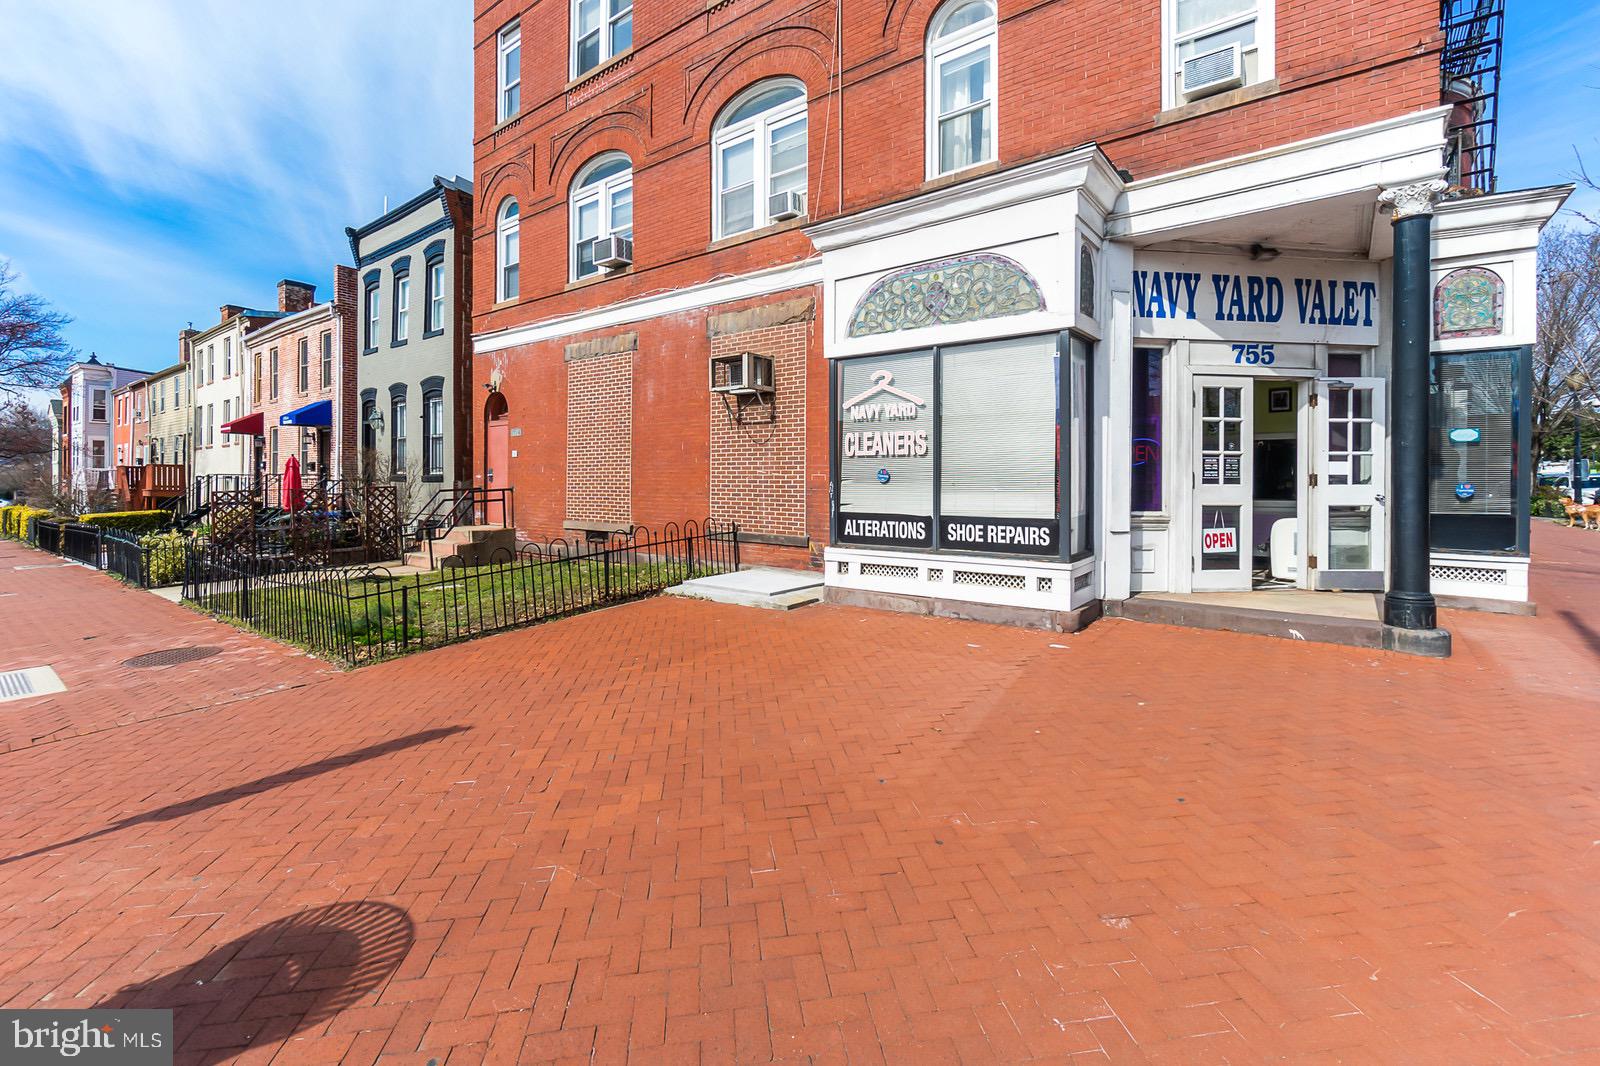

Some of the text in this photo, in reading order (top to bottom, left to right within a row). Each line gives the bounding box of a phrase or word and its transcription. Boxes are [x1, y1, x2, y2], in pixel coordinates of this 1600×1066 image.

[1133, 270, 1377, 327] NAVY YARD VALET
[1231, 343, 1275, 365] 755
[850, 403, 916, 420] NAVY YARD
[845, 430, 928, 457] CLEANERS
[844, 518, 926, 540] ALTERATIONS
[947, 523, 1050, 547] SHOE REPAIRS
[1204, 531, 1233, 550] OPEN
